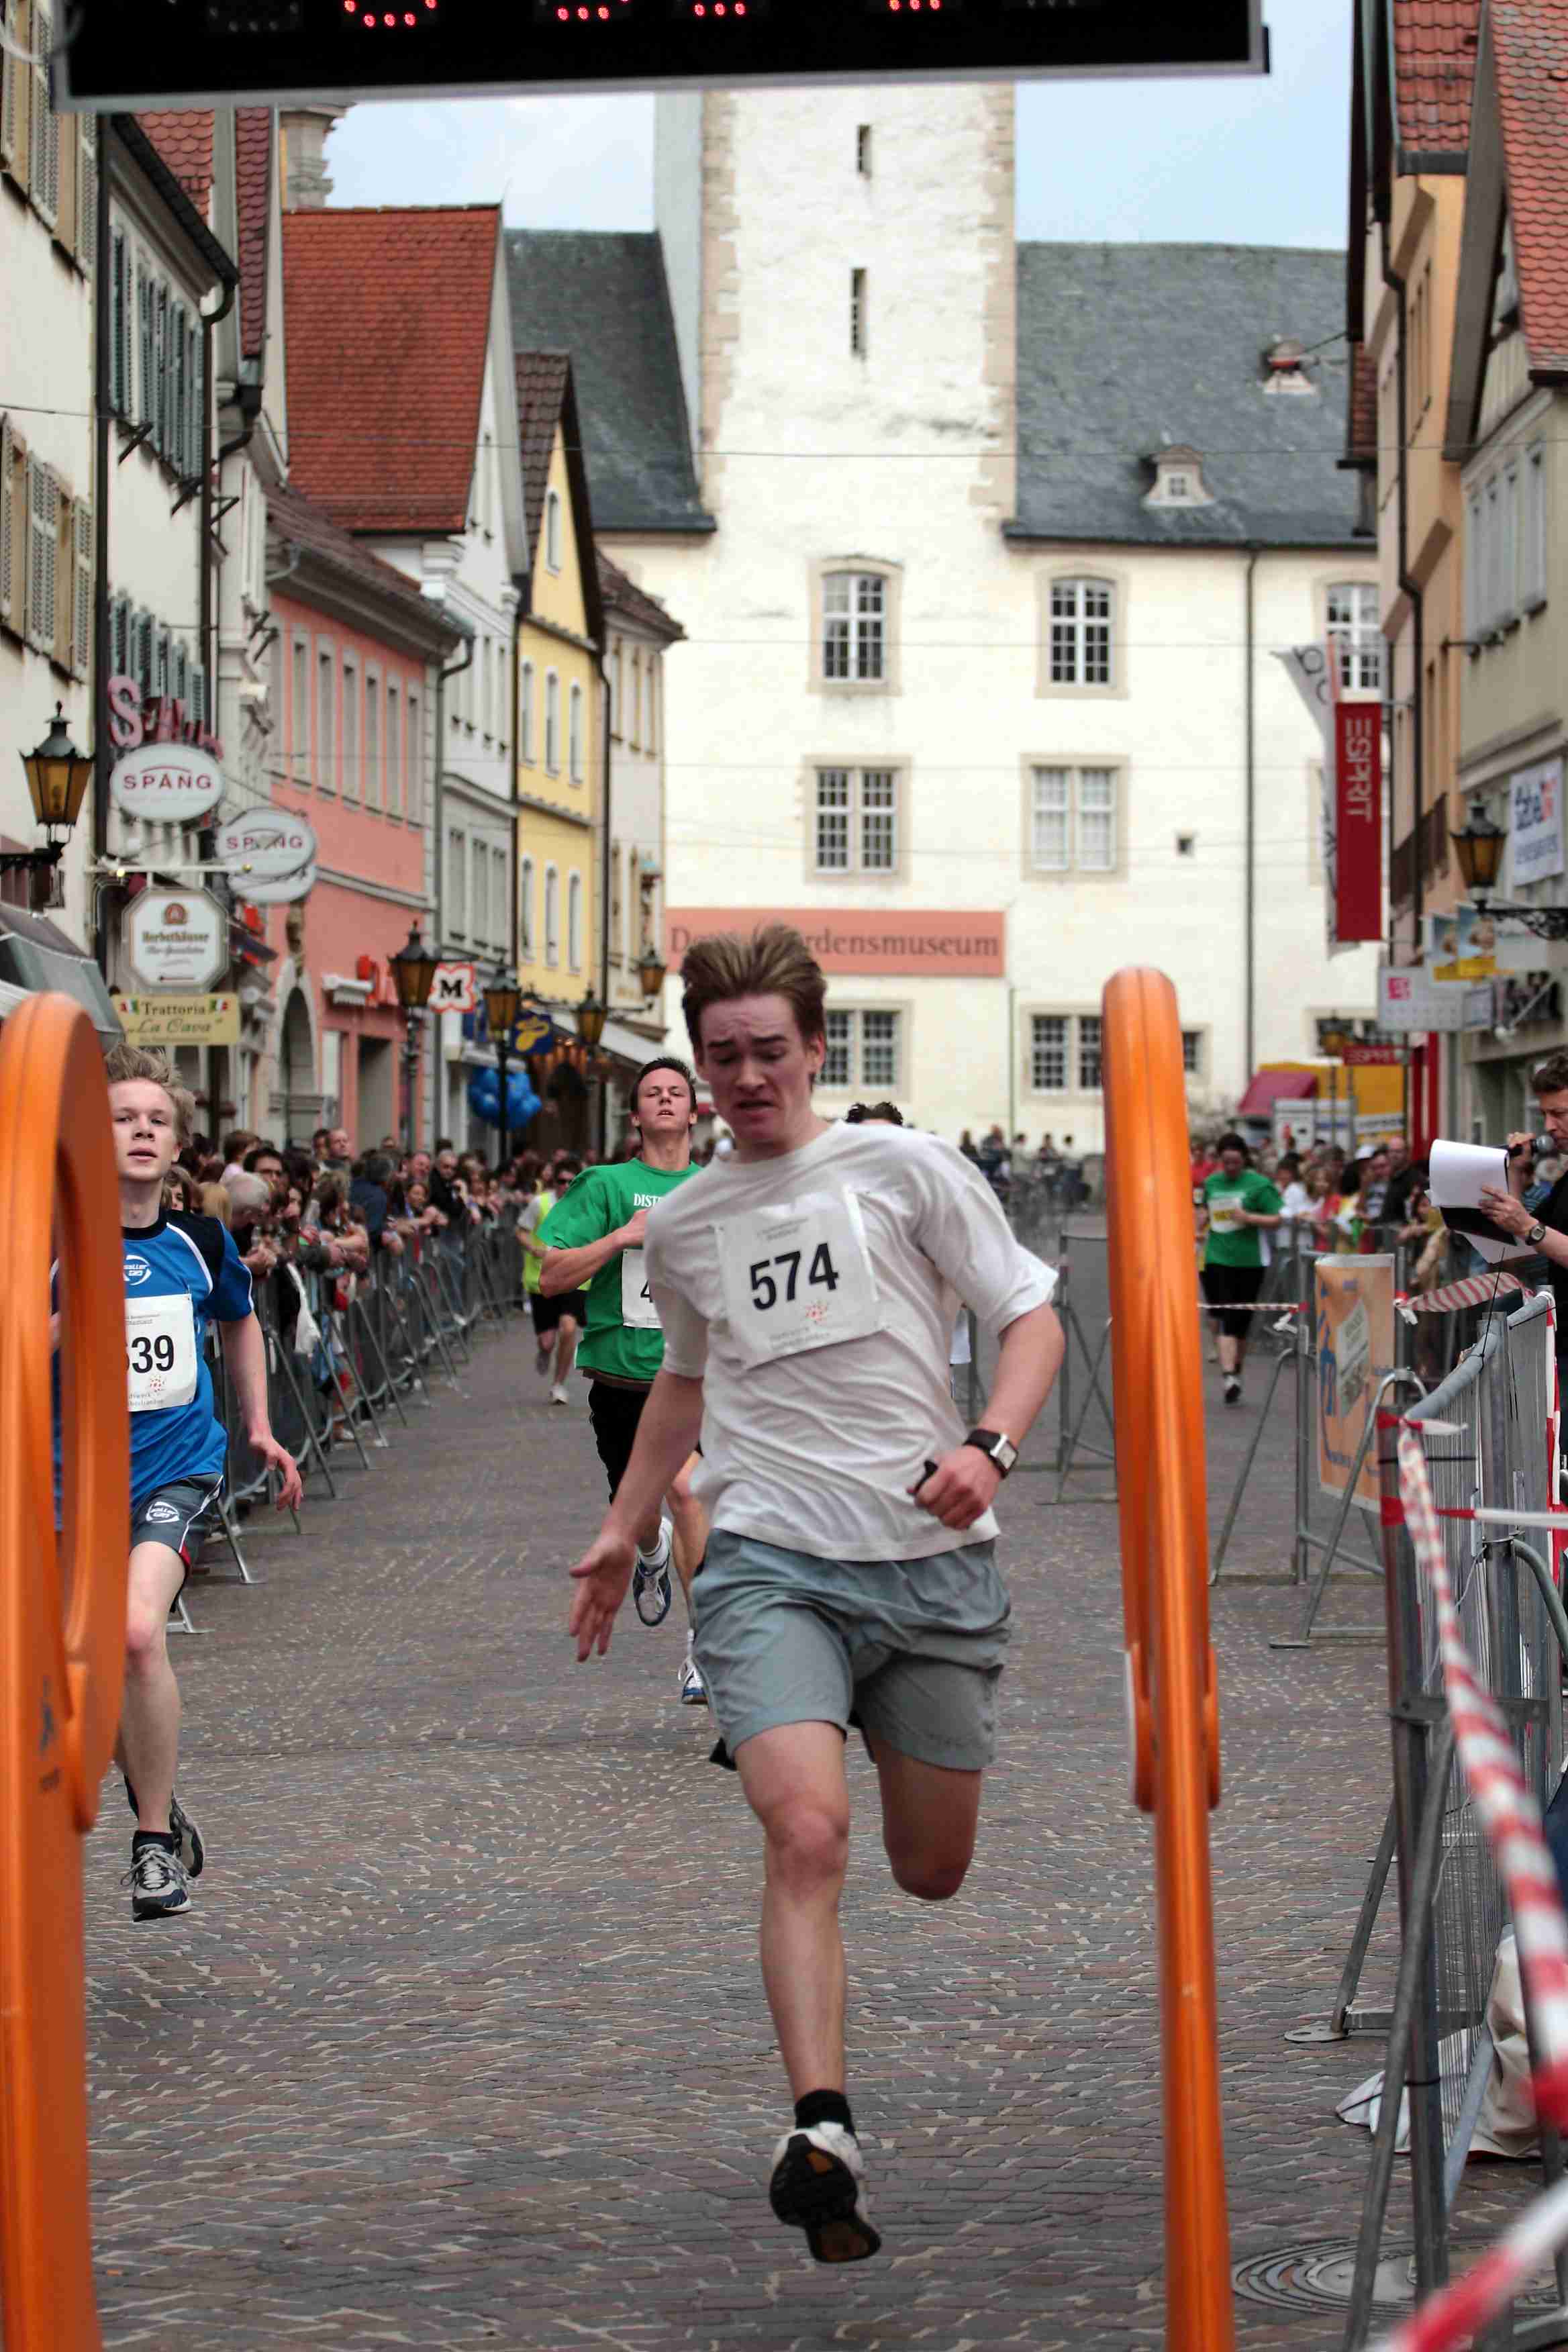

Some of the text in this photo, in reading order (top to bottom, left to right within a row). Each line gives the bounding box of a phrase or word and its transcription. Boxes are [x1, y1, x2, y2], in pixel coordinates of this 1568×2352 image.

[124, 773, 211, 790] SPANG
[1345, 718, 1373, 824] ESPRIT
[226, 836, 303, 850] SPNG
[671, 926, 999, 957] Drdensmuseum
[440, 979, 462, 998] M
[142, 1001, 205, 1016] Trattoria
[750, 1242, 840, 1311] 574
[126, 1334, 175, 1374] 39
